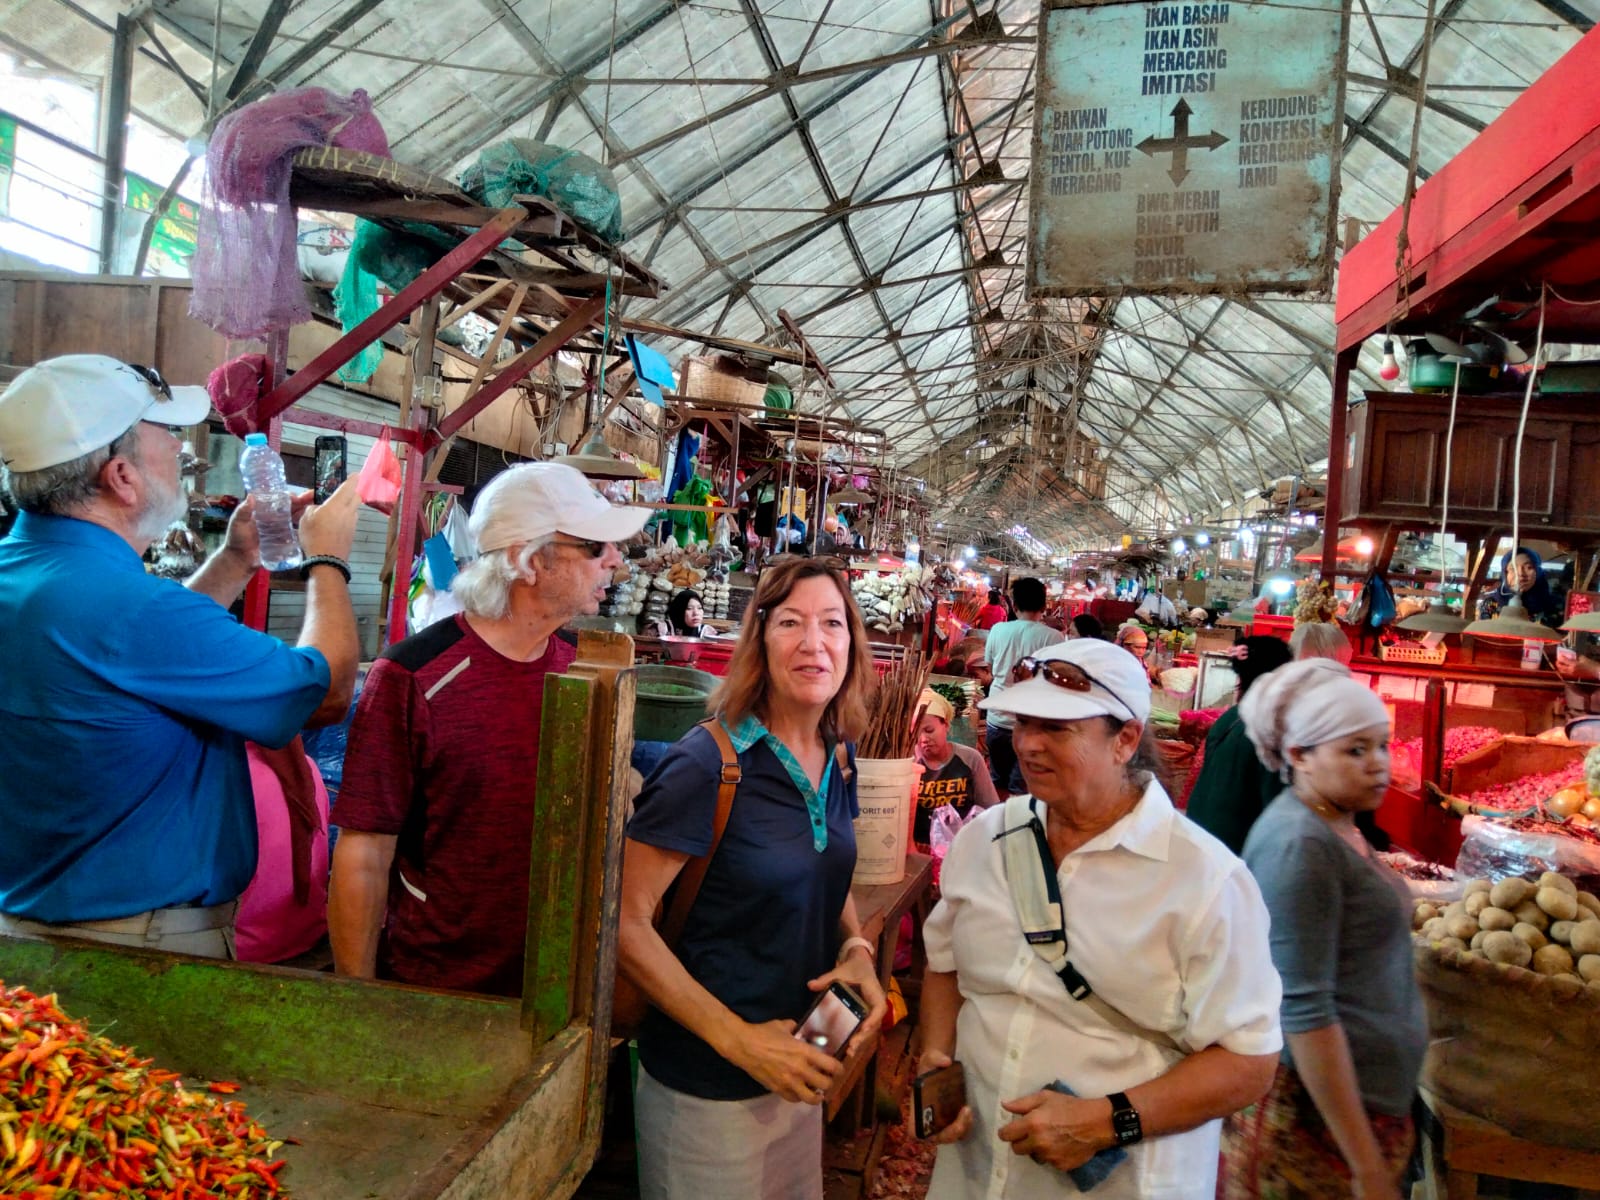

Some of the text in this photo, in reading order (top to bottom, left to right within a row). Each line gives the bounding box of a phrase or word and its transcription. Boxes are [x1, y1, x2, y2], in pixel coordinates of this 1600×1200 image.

[1146, 4, 1229, 28] IKAN BASAH
[1144, 27, 1218, 50] IKAN ASIN
[1143, 49, 1227, 73] MERACANG
[1142, 72, 1216, 96] IMITASI
[1053, 107, 1107, 130] BAKWAN
[1241, 95, 1317, 121] KERUDUNG
[1086, 128, 1133, 150] POTONG
[1240, 118, 1316, 143] KONFEKSI
[1104, 151, 1131, 169] KUE
[1050, 172, 1122, 195] MERACANG
[1238, 166, 1278, 188] JAMU
[918, 778, 967, 796] GREEN
